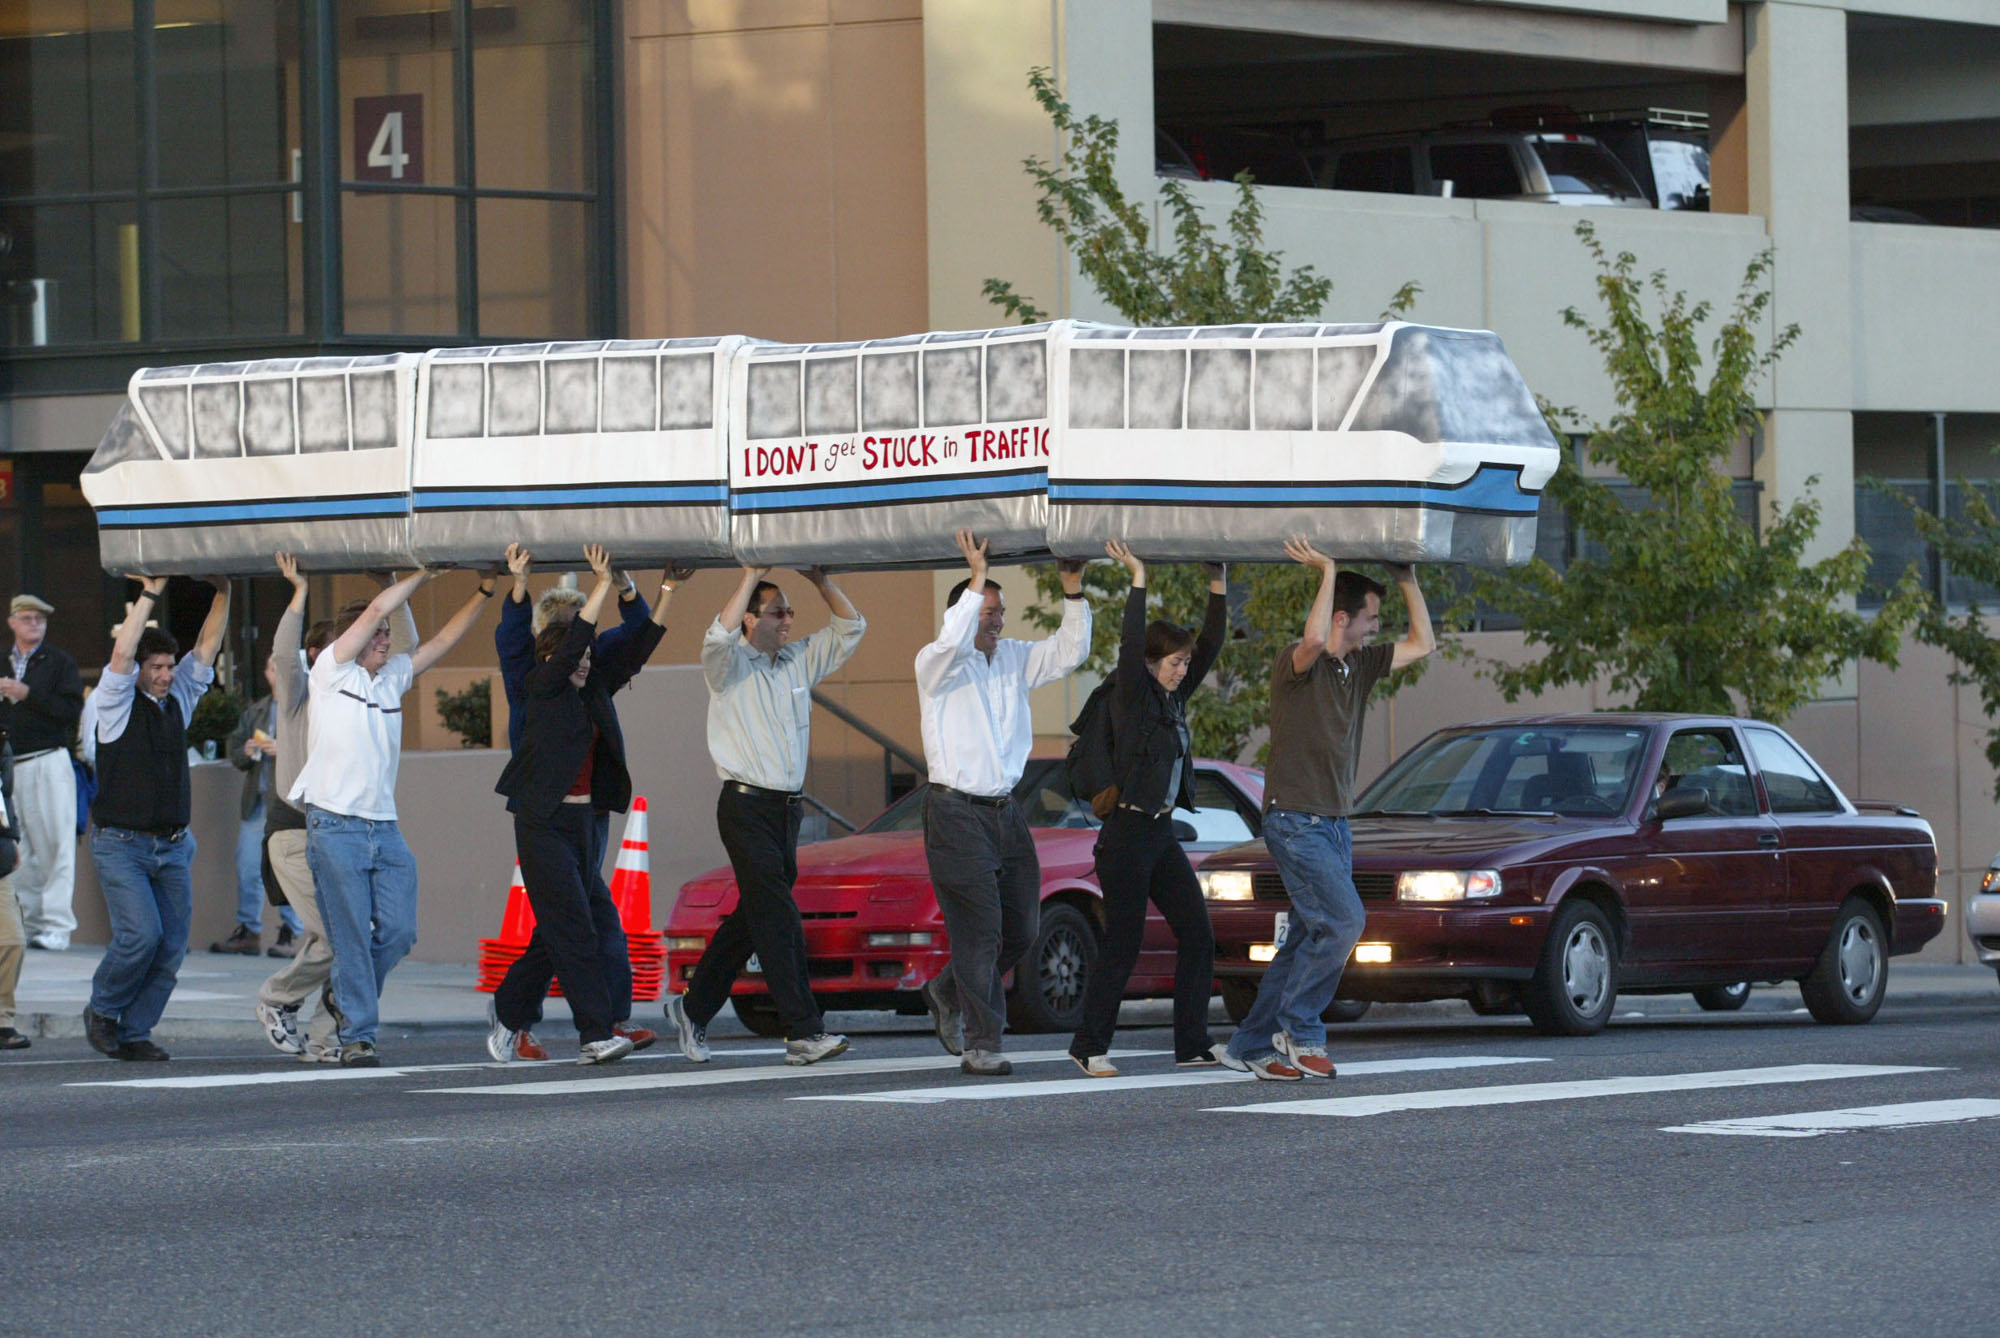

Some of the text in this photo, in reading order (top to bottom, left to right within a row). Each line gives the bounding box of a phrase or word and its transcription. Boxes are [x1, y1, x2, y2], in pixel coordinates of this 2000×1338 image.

[367, 111, 410, 179] 4
[744, 447, 751, 477] I
[757, 441, 819, 476] DON'T
[824, 437, 856, 472] get
[862, 435, 939, 471] STUCK
[943, 435, 958, 459] in
